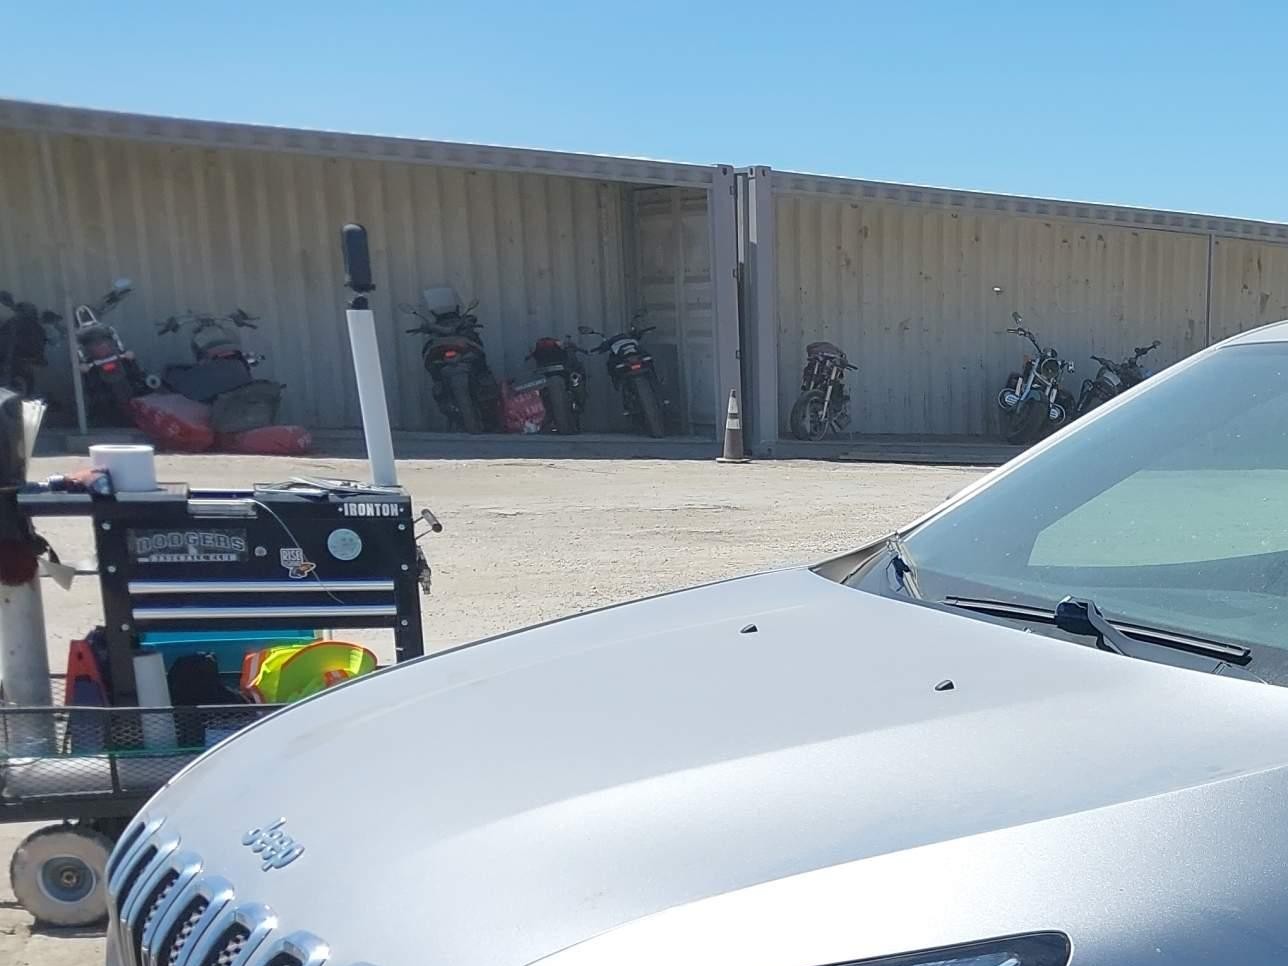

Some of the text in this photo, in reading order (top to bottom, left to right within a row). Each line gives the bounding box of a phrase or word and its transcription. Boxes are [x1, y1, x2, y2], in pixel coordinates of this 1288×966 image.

[343, 502, 400, 517] IRONTON
[136, 531, 246, 555] DODGERS
[281, 549, 302, 561] RISE
[241, 816, 306, 873] Jeep
